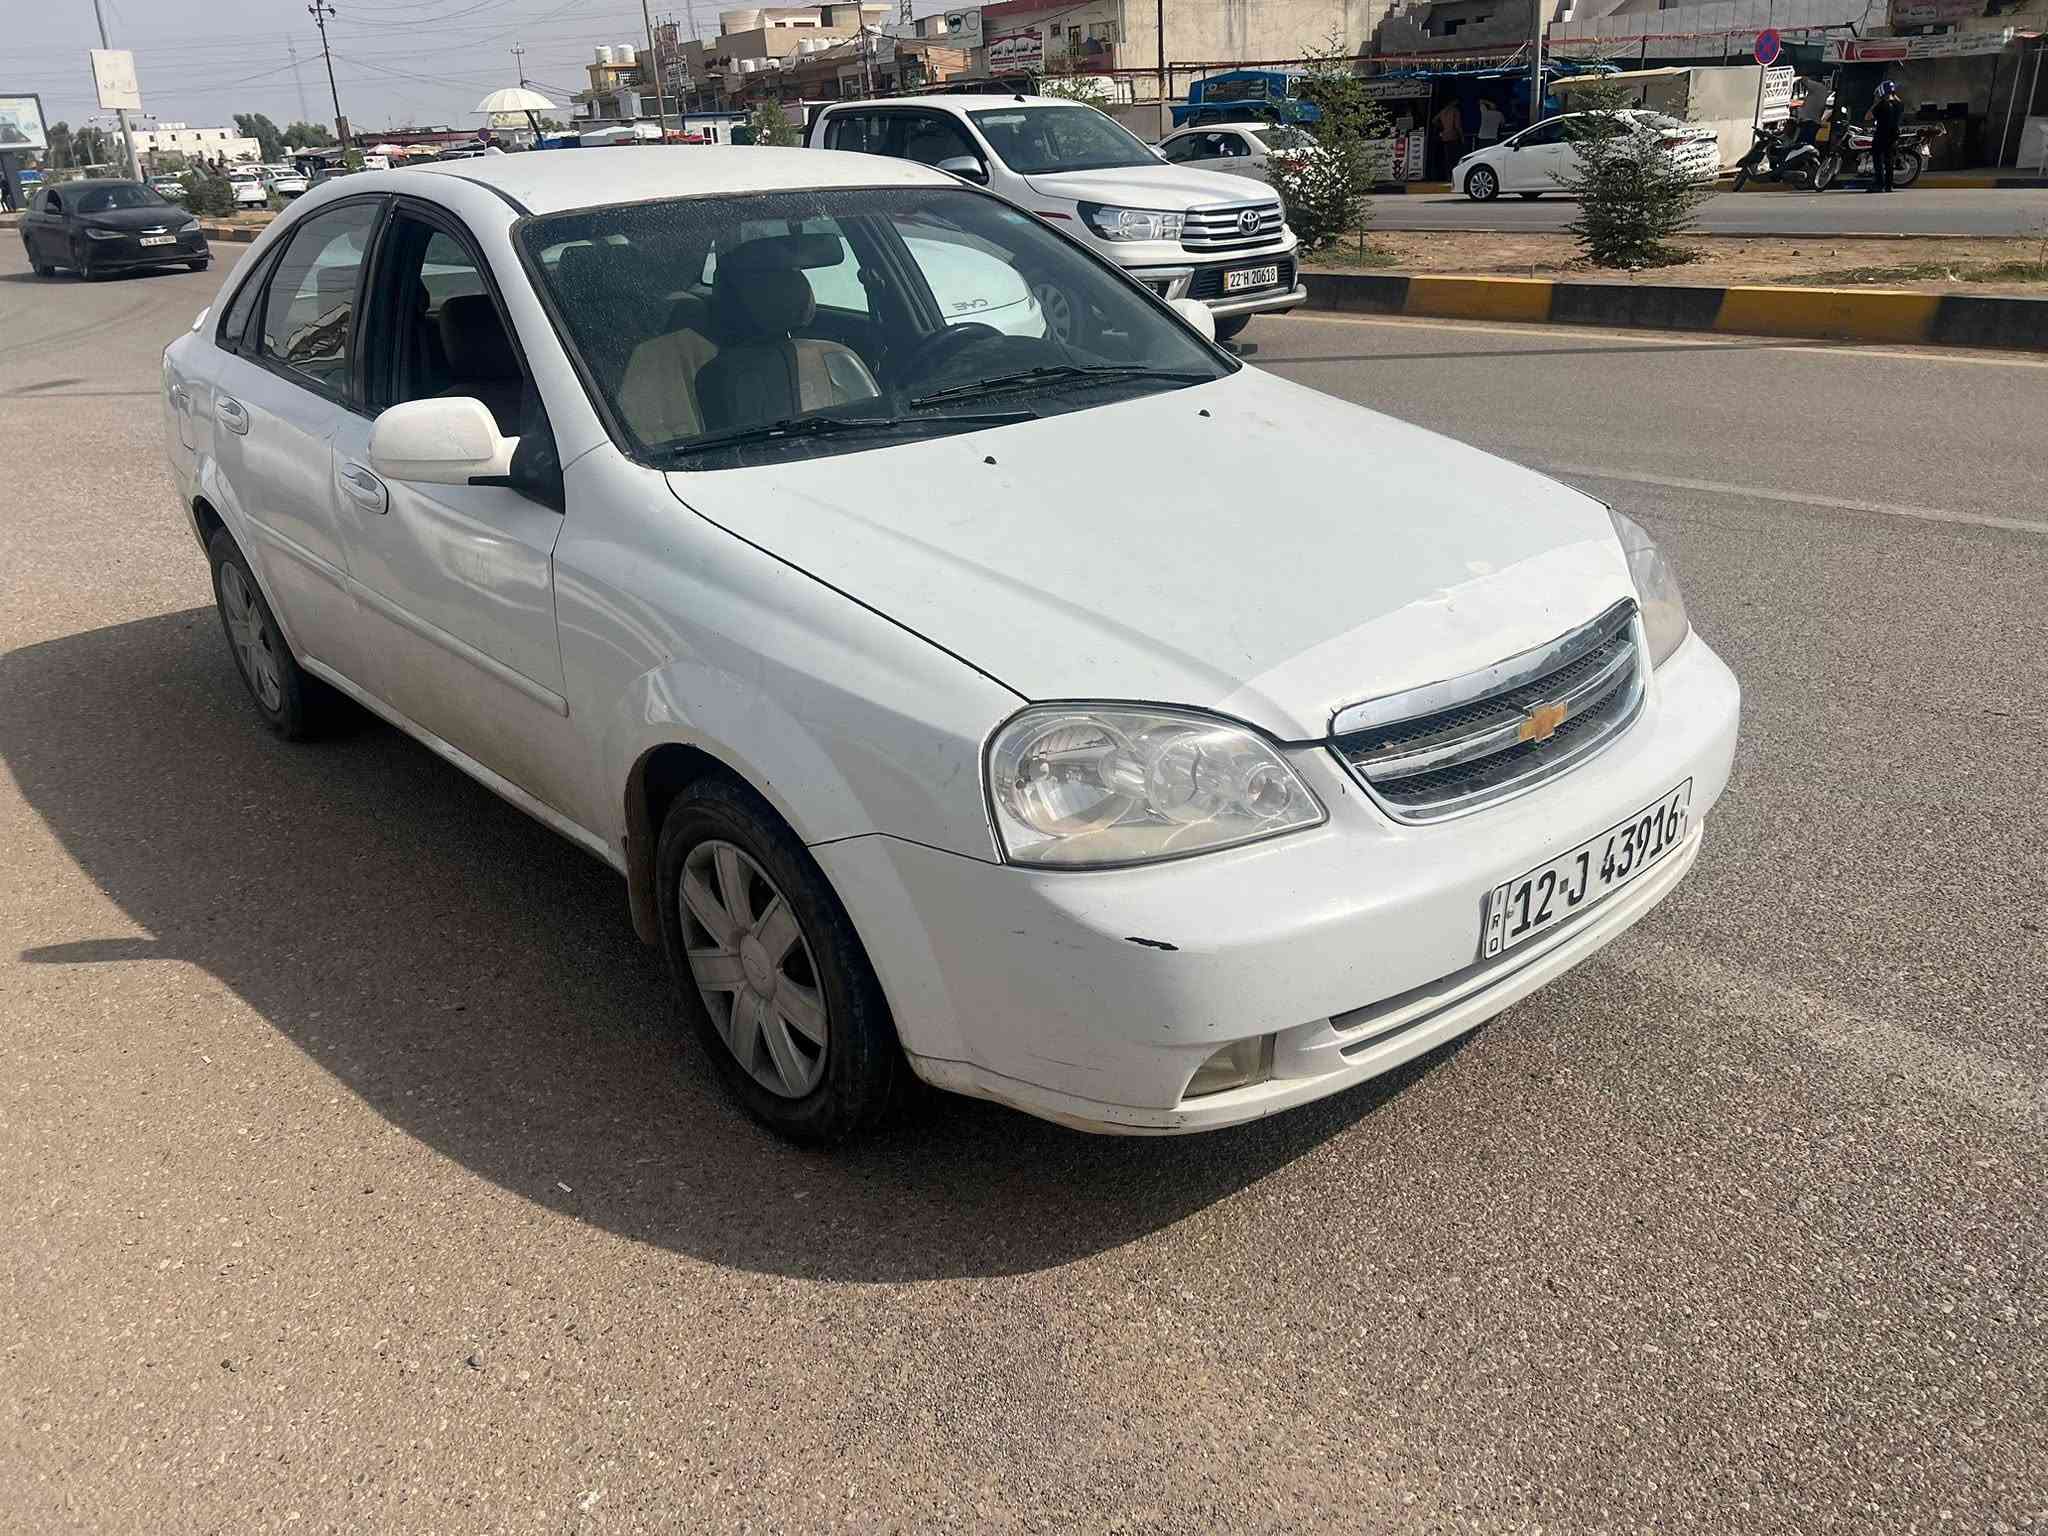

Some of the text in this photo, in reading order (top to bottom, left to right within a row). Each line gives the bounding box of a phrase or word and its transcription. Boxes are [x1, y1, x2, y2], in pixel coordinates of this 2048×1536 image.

[1230, 273, 1241, 288] 22
[1251, 267, 1276, 285] 20618
[1511, 794, 1682, 938] 12 J 43916
